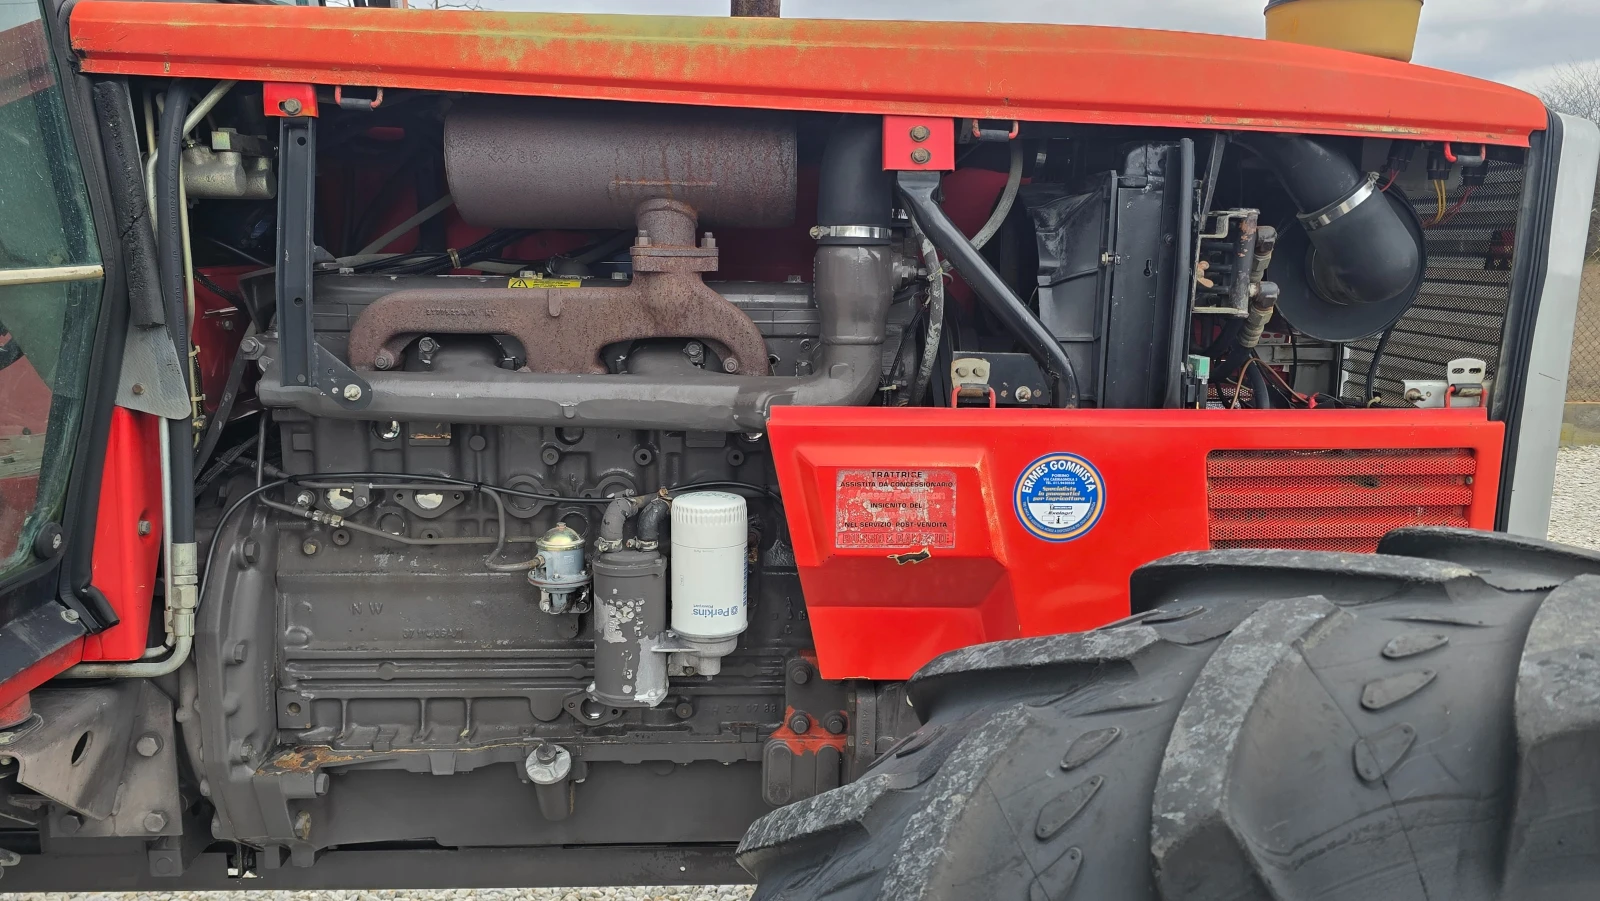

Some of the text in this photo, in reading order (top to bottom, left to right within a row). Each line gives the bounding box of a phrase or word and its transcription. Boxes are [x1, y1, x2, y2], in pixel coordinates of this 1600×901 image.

[1021, 460, 1097, 493] ERMES GOMMISTA
[693, 607, 730, 618] Perkins
